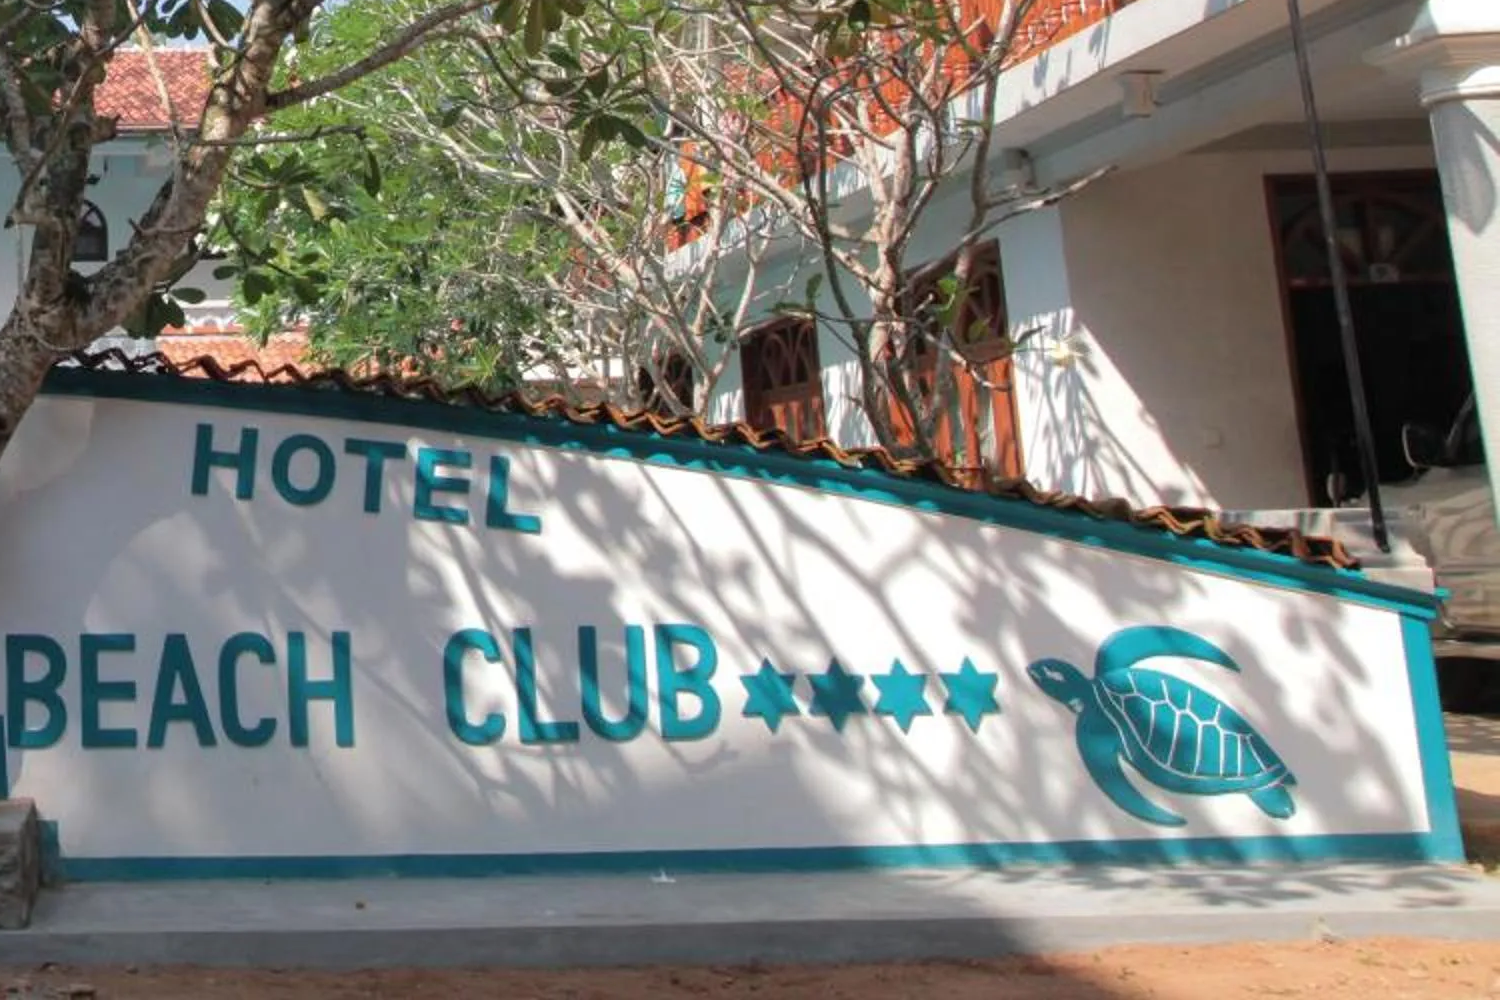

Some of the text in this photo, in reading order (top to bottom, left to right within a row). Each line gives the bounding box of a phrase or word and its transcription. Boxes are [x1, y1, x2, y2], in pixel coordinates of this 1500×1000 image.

[191, 423, 542, 534] HOTEL
[5, 631, 356, 749] BEACH
[443, 624, 722, 744] CLUB
